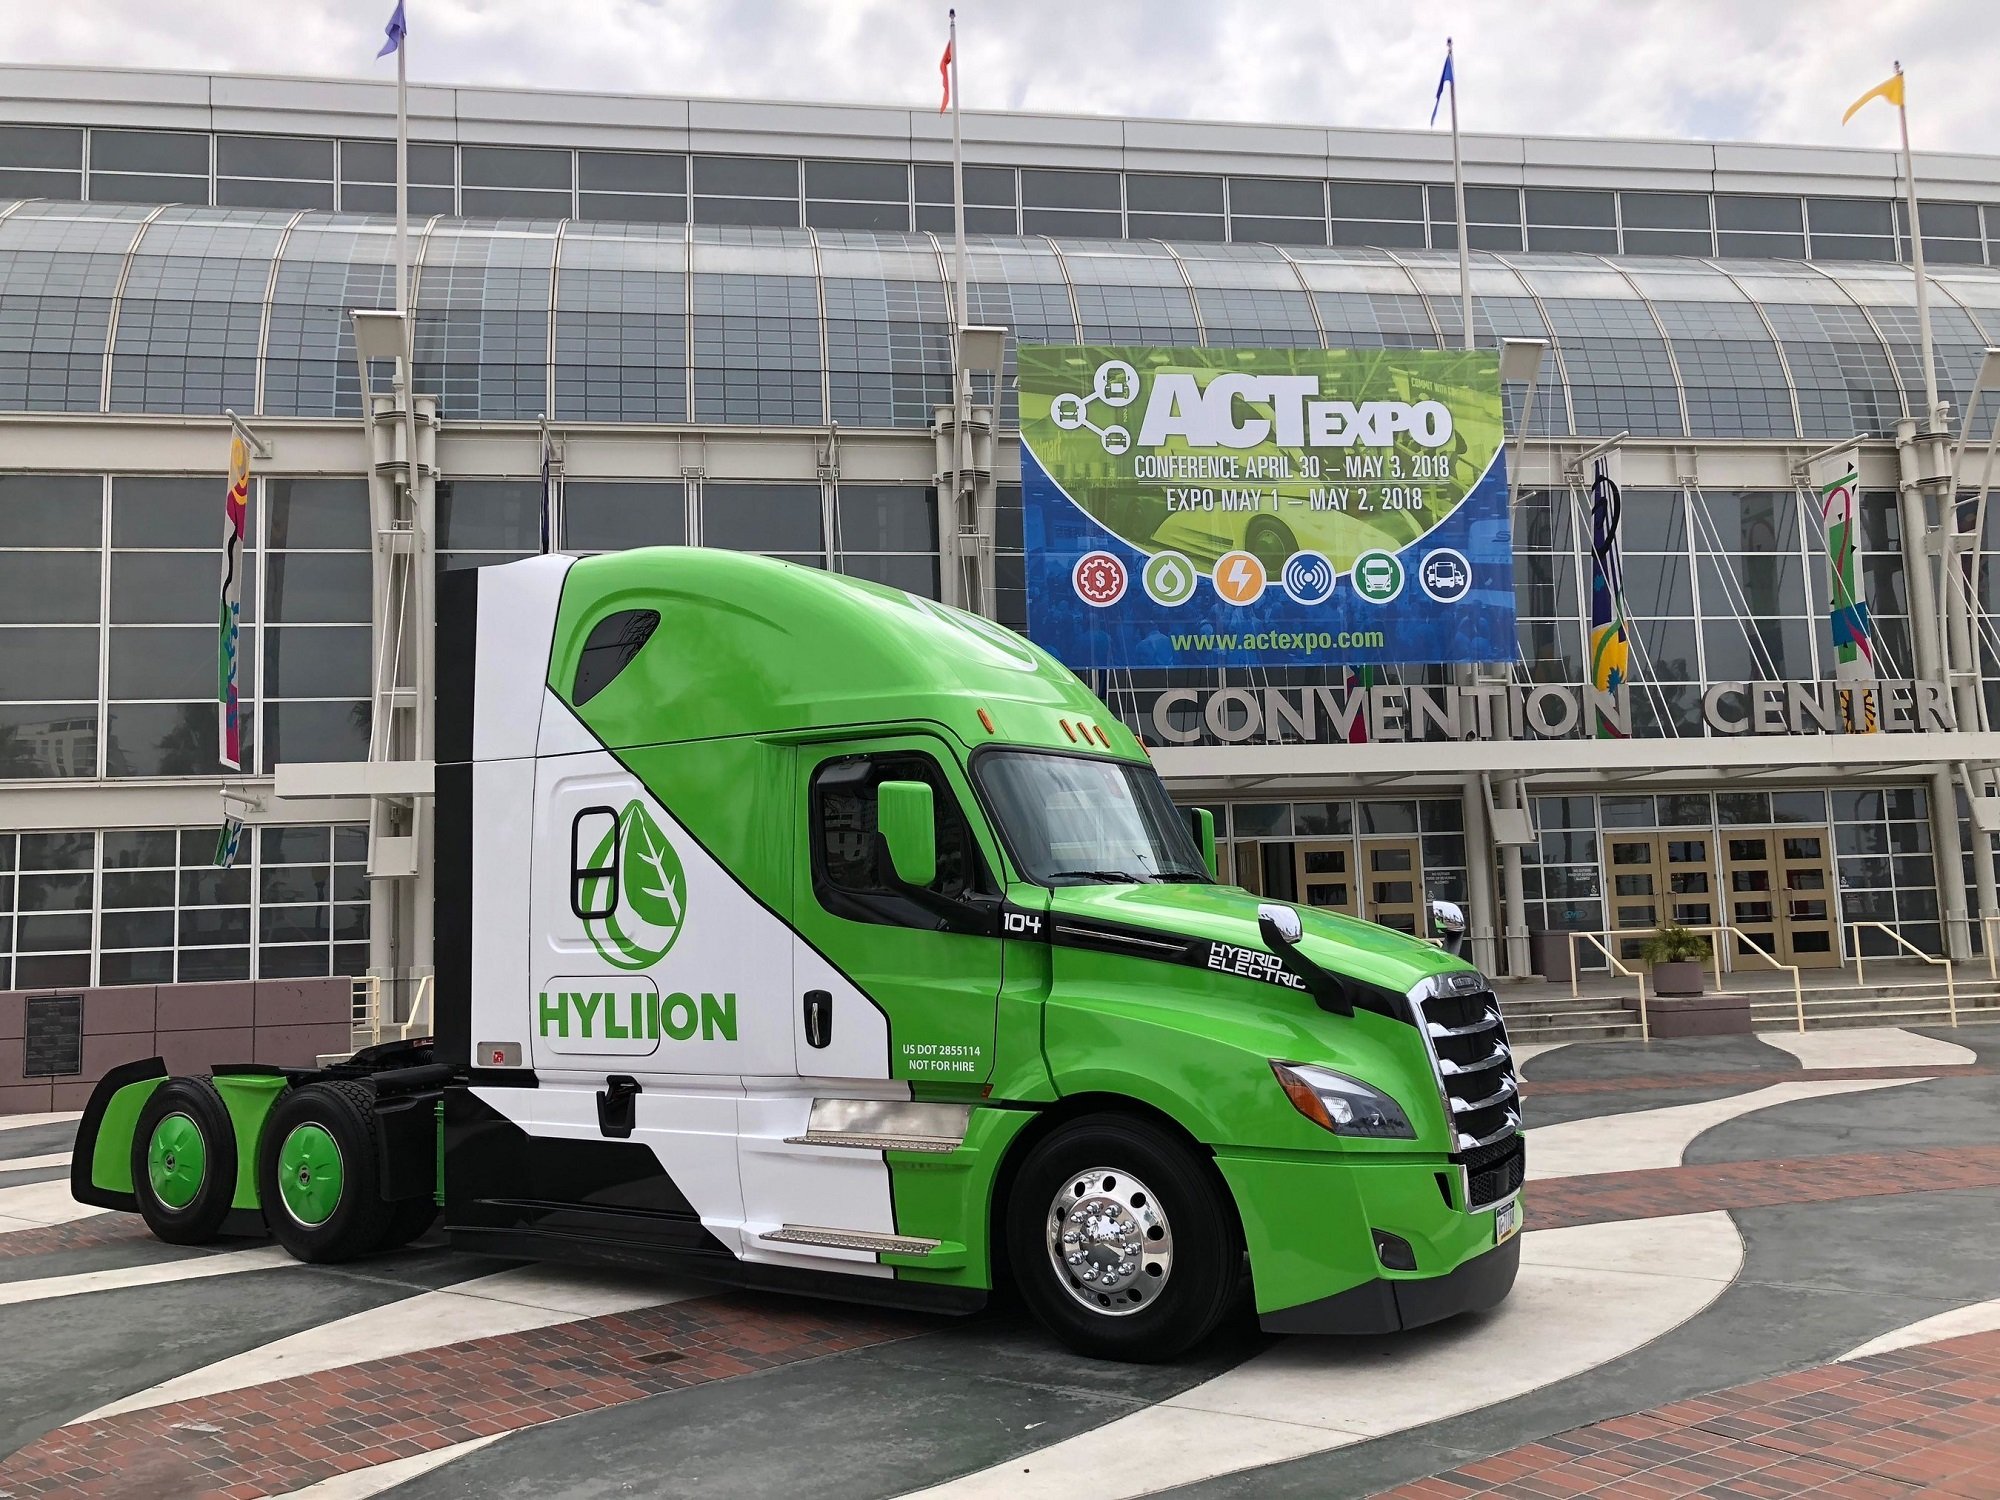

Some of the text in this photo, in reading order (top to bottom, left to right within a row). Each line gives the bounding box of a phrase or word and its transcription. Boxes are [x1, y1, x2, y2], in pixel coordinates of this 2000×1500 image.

[1137, 373, 1452, 447] ACT EXPO
[1134, 455, 1240, 478] CONFERENCE
[1245, 455, 1294, 478] APRIL
[1299, 455, 1320, 478] 30
[1345, 455, 1384, 477] MAY
[1391, 455, 1405, 479] 3,
[1412, 455, 1450, 477] 2018
[1167, 488, 1214, 511] EXPO
[1221, 488, 1262, 511] MAY
[1271, 488, 1279, 511] 1
[1310, 488, 1350, 510] MAY
[1358, 488, 1374, 511] 2,
[1382, 487, 1422, 510] 2018
[1171, 630, 1384, 654] www.actexpo.com
[1153, 680, 1956, 743] CONVENTION CENTER
[1003, 912, 1042, 934] 104
[1210, 942, 1283, 970] HYBRID
[1207, 954, 1306, 989] ELECTRIC
[539, 992, 738, 1041] HYLIION
[902, 1044, 980, 1056] US DOT 2855114
[909, 1060, 975, 1072] NOT FOR HIRE
